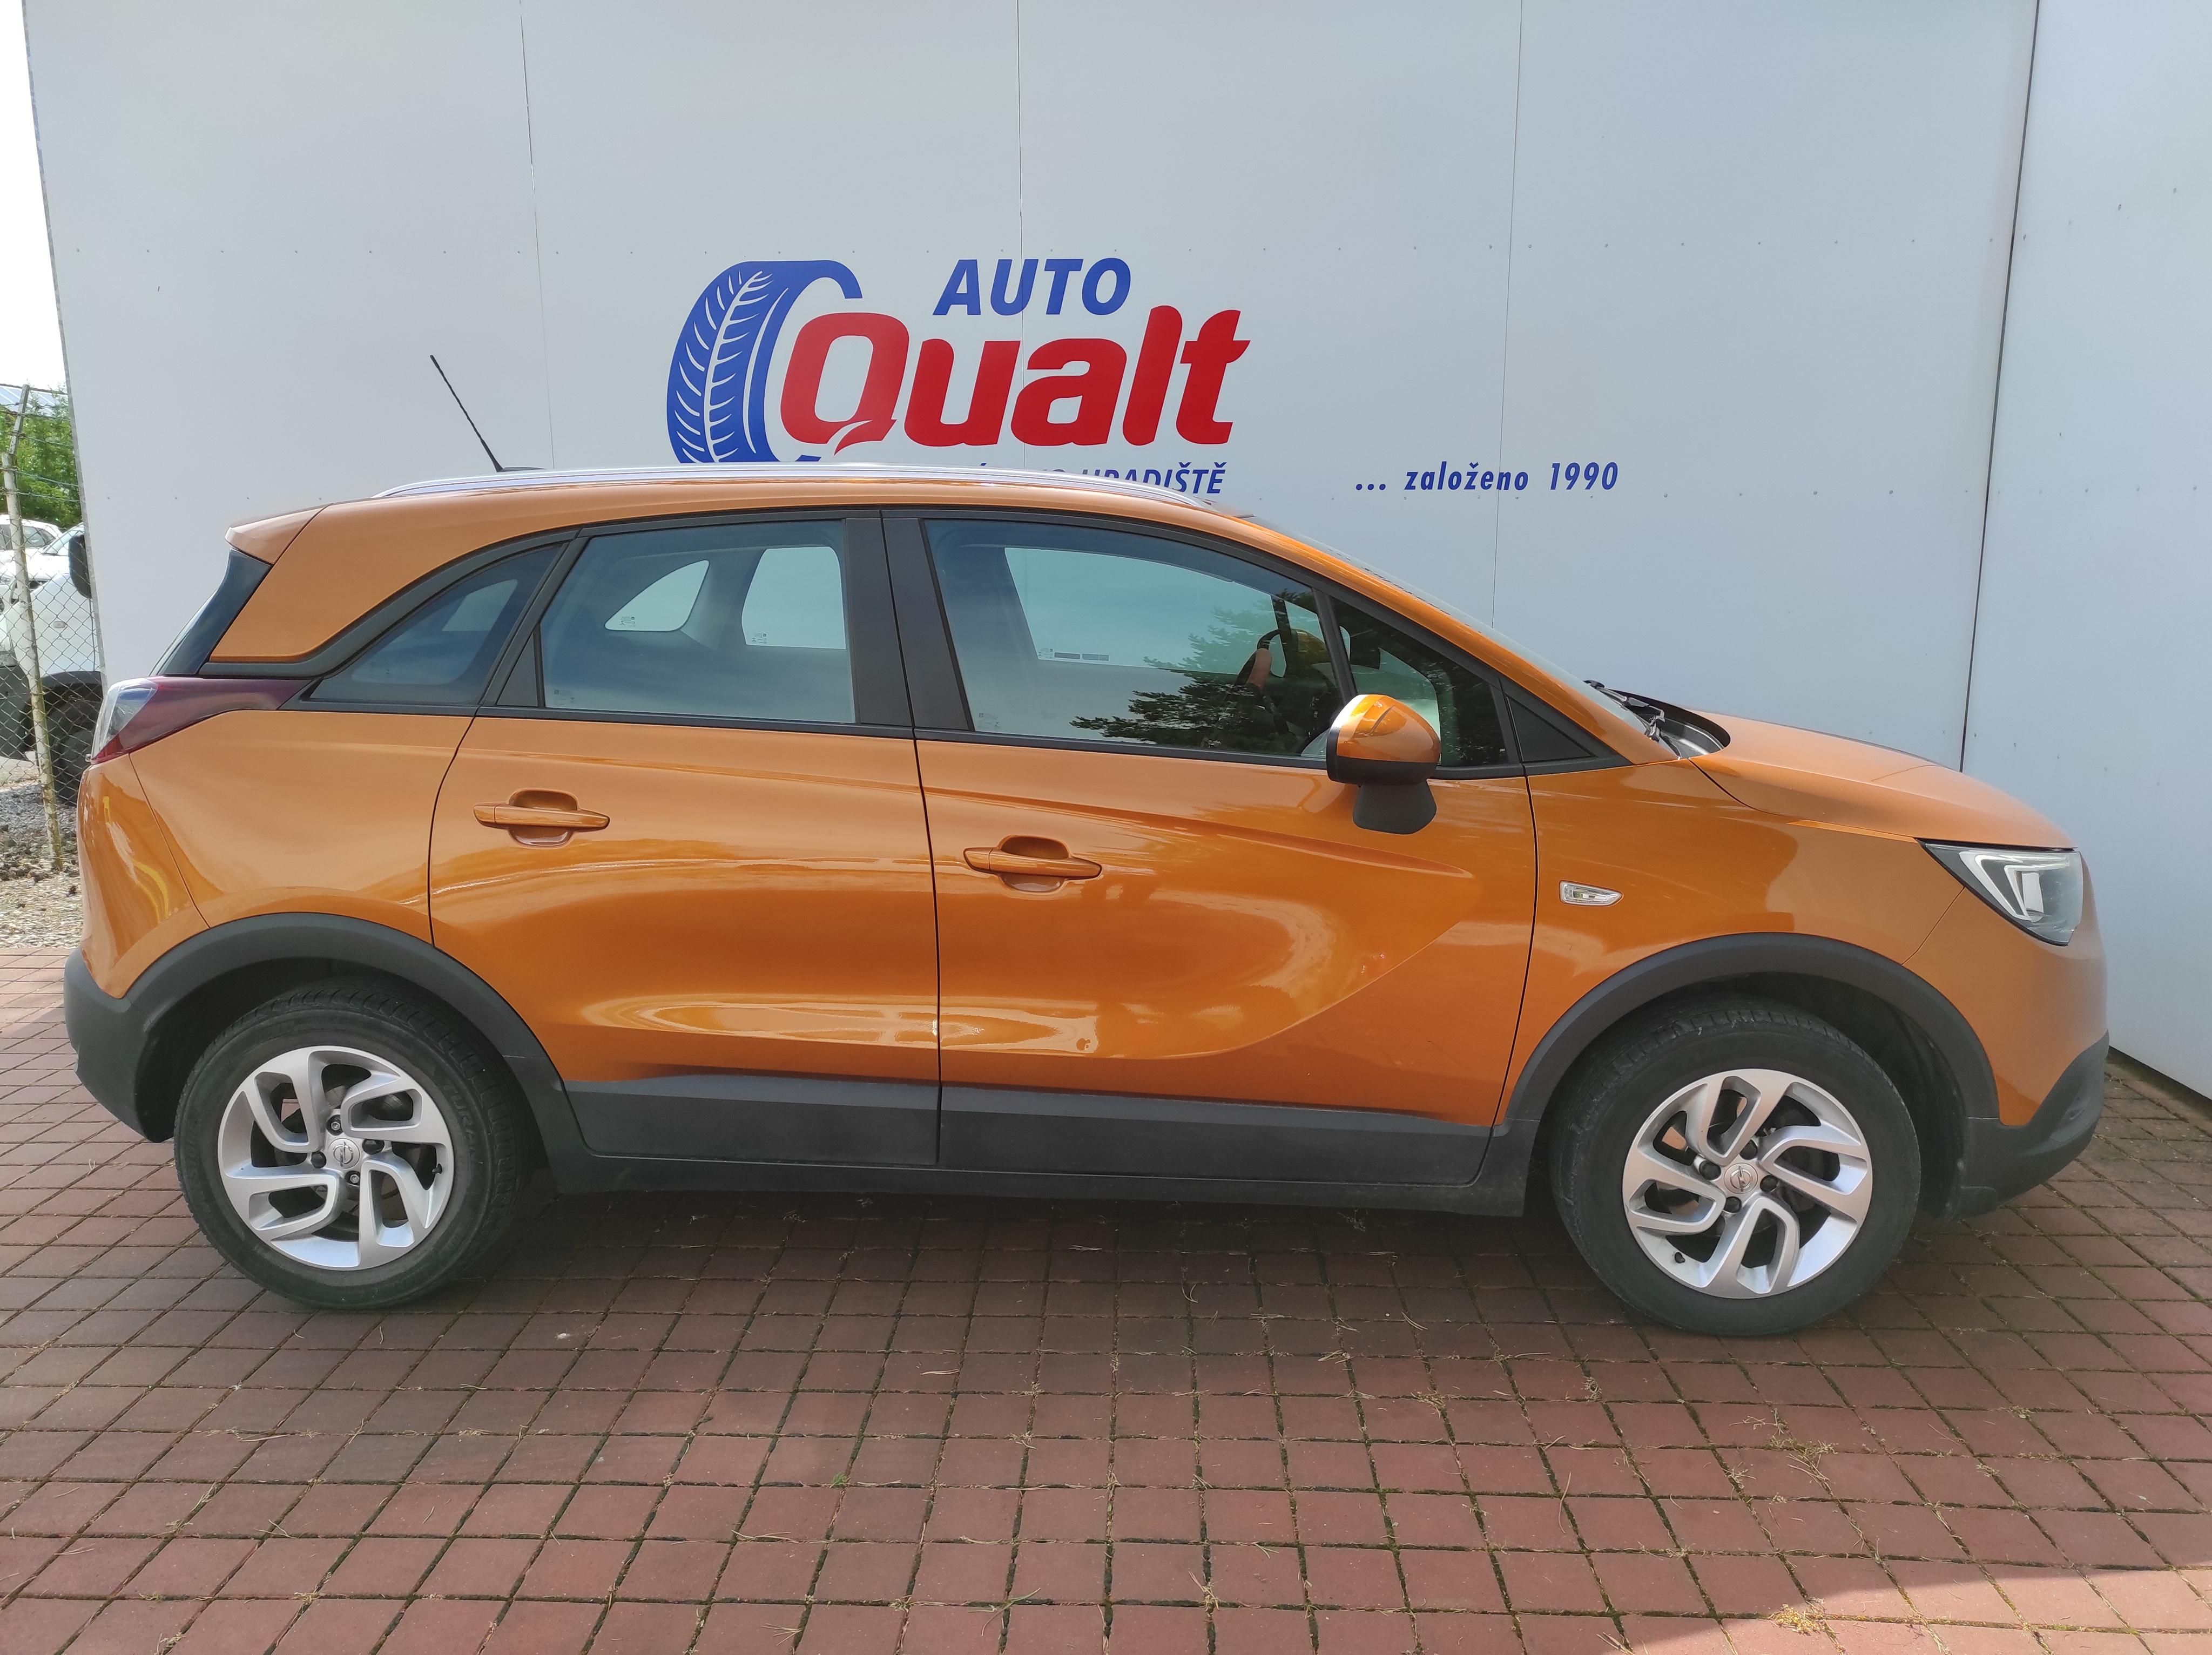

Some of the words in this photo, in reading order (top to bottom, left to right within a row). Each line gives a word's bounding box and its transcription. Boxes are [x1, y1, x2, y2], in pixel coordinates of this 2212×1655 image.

[933, 257, 1131, 316] AUTO
[781, 305, 1250, 455] Qualt
[1082, 462, 1227, 494] DIŠTĚ
[1404, 461, 1528, 491] založeno
[1550, 462, 1618, 491] 1990
